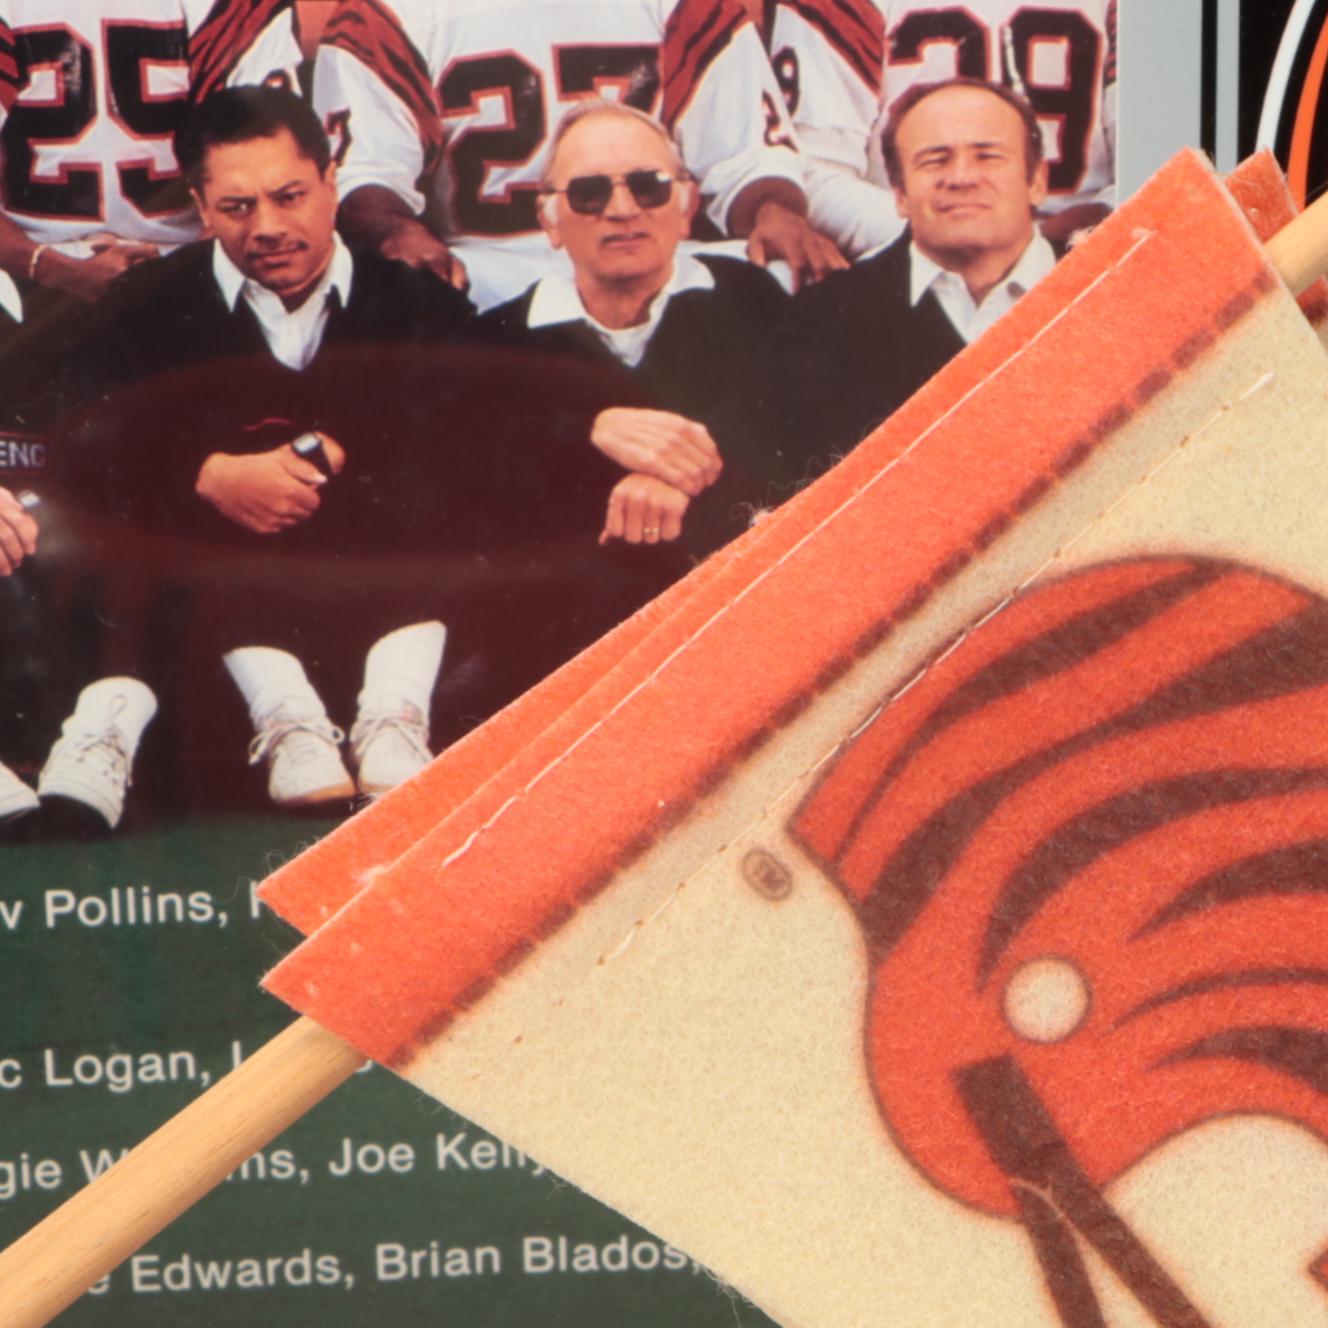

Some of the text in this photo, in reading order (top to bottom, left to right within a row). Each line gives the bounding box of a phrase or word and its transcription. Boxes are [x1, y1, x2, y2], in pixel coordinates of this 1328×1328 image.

[0, 18, 188, 223] 25
[45, 887, 228, 927] Pollins,
[45, 1048, 210, 1092] Logan,
[329, 1138, 414, 1176] Joe
[131, 1248, 354, 1293] Edwards,
[376, 1241, 499, 1281] Brian
